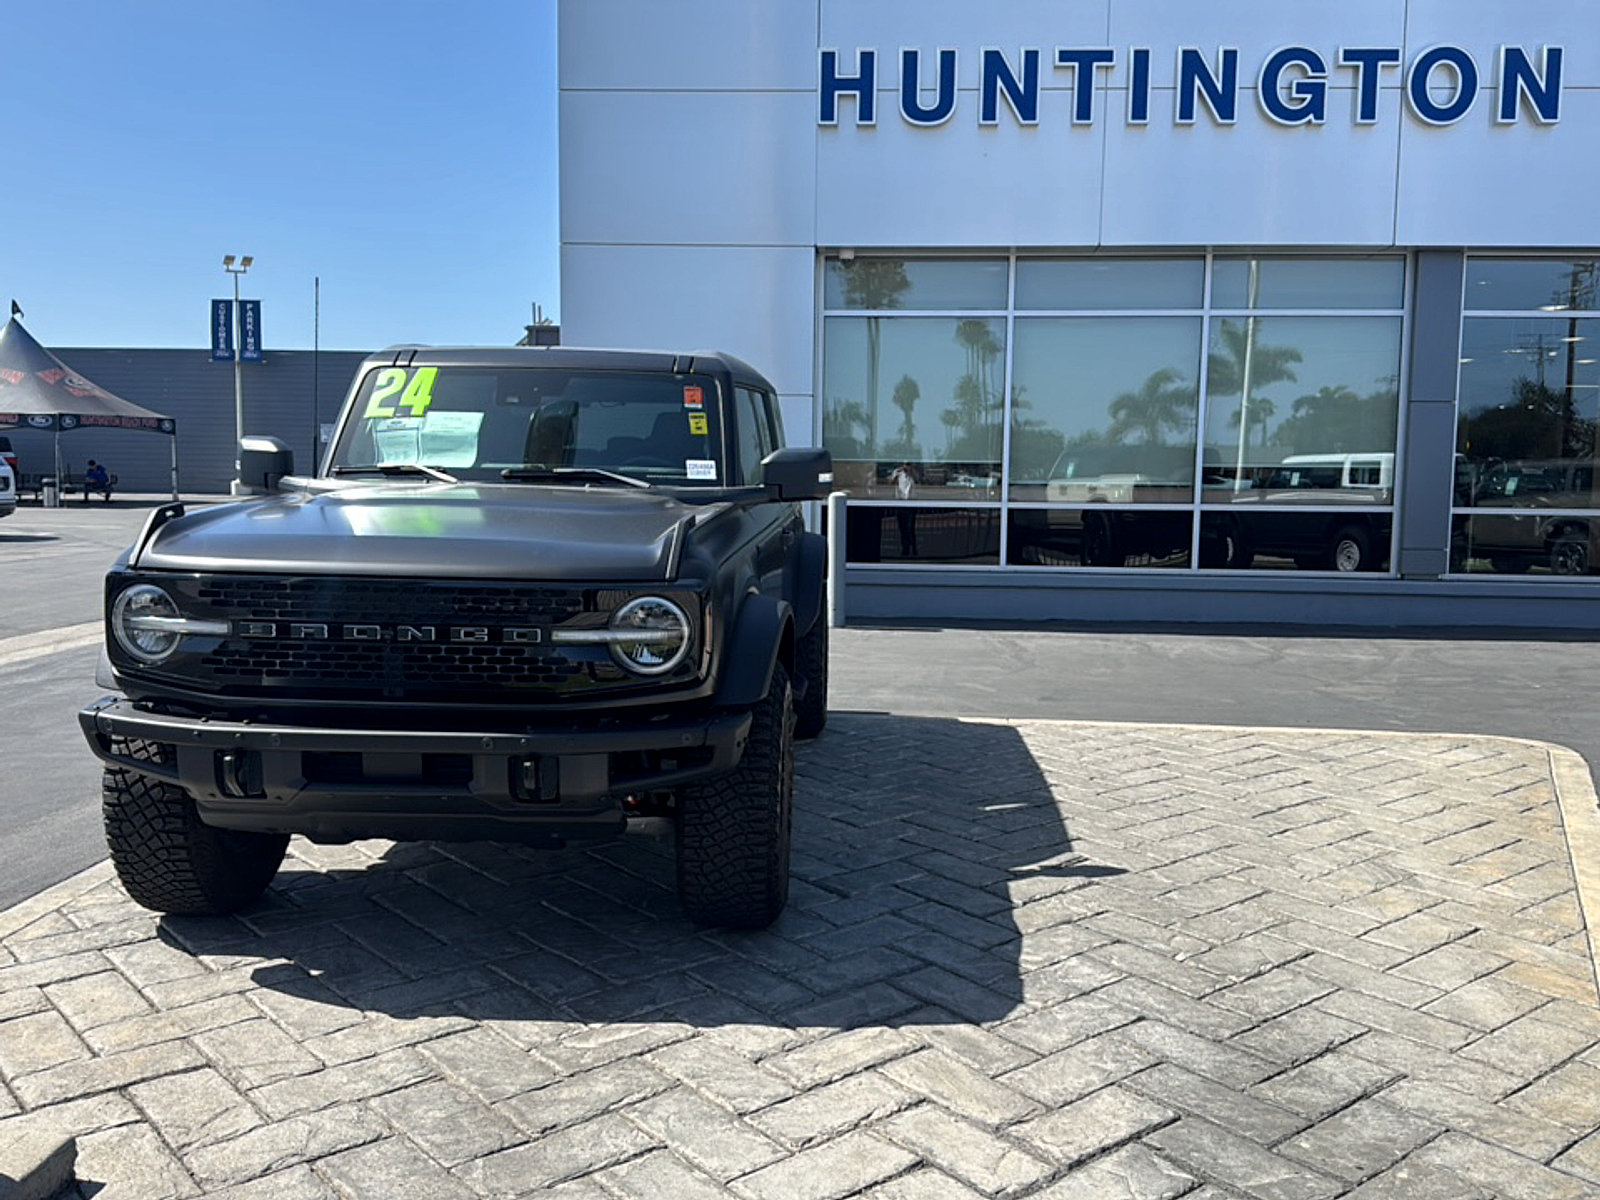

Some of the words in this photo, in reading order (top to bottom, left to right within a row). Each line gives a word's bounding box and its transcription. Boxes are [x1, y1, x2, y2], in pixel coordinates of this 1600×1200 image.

[818, 44, 1564, 127] HUNTINGTON
[246, 303, 254, 350] PARKING
[363, 366, 438, 418] 24
[239, 621, 541, 643] BRONCO
